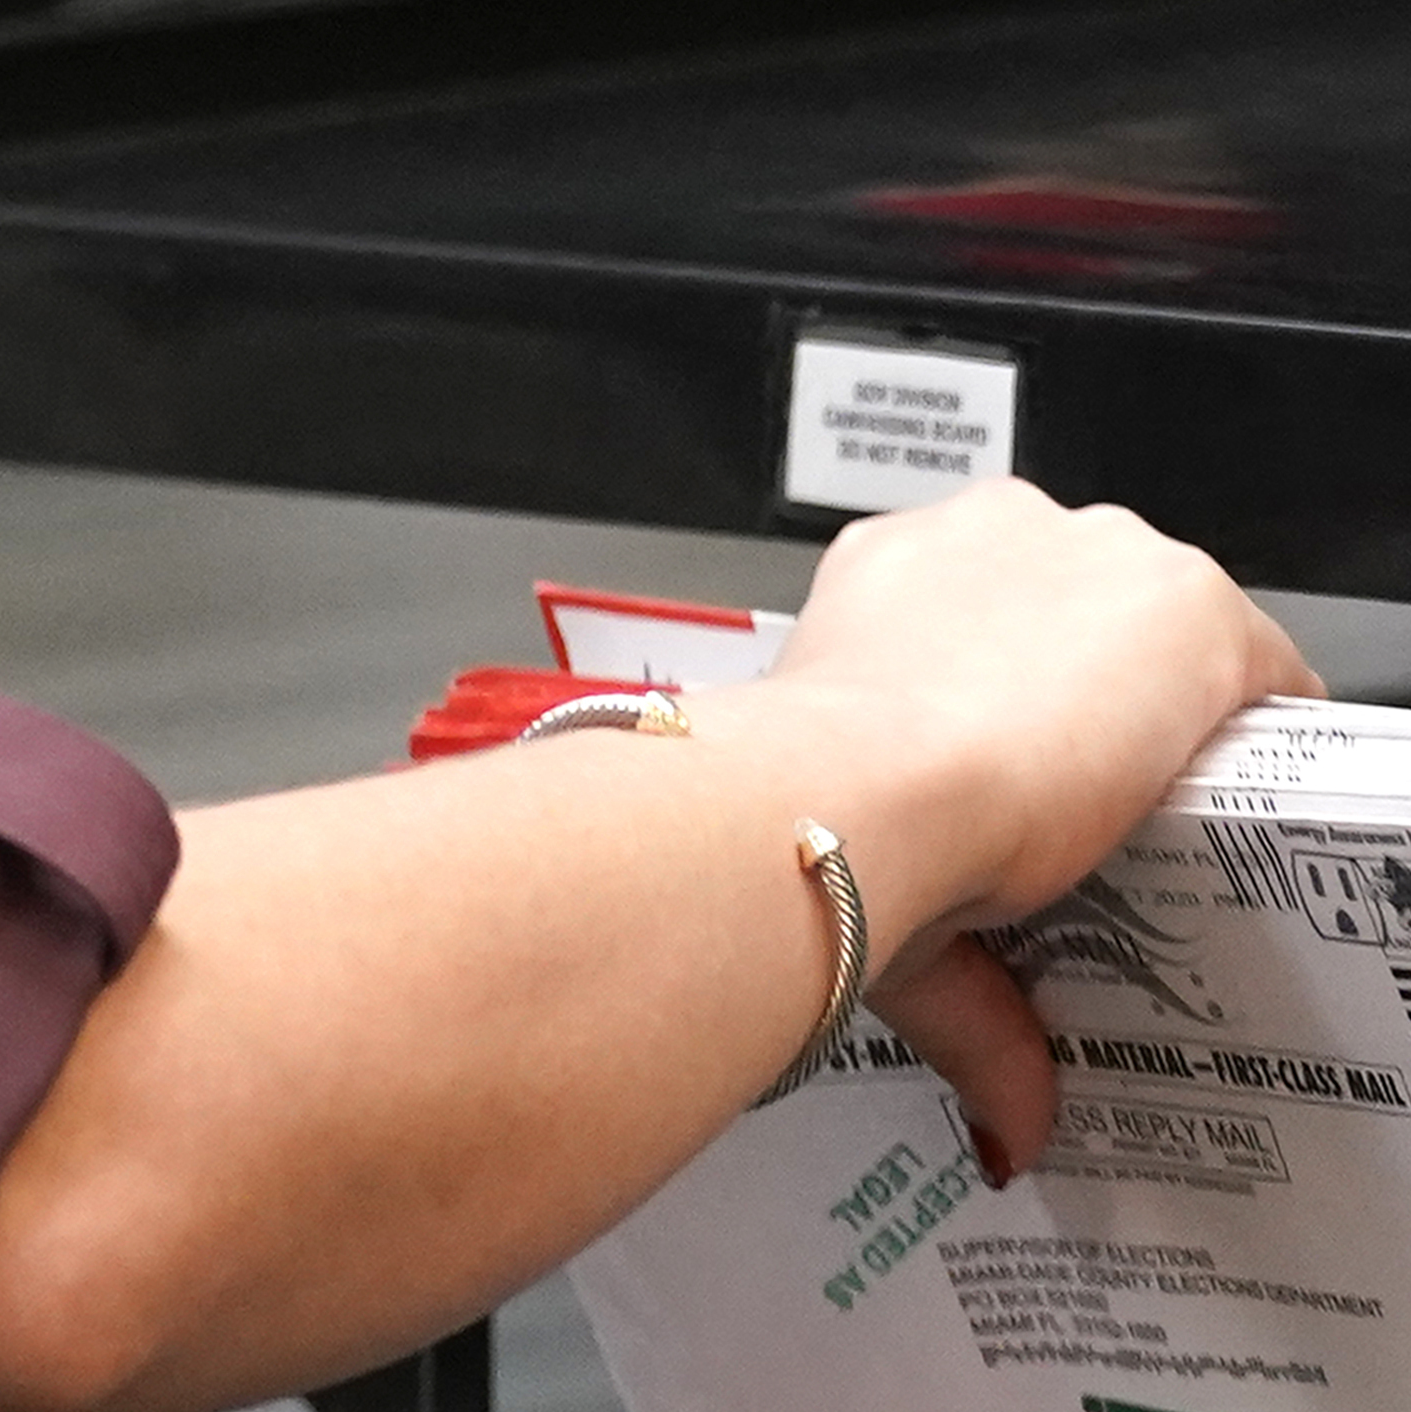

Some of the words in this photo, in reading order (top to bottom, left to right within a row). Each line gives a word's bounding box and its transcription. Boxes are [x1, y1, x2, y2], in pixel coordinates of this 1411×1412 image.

[1346, 1067, 1407, 1107] MAIL
[1111, 1107, 1197, 1144] REPLY
[1203, 1118, 1265, 1152] MAIL
[830, 1142, 926, 1234] LEGAL
[1106, 1242, 1217, 1271] ELECTIONS
[1075, 1266, 1155, 1291] COUNTY
[1155, 1273, 1263, 1301] ELECTIONS
[1264, 1282, 1385, 1318] DEPARTMENT
[970, 1313, 1036, 1338] MIAMI
